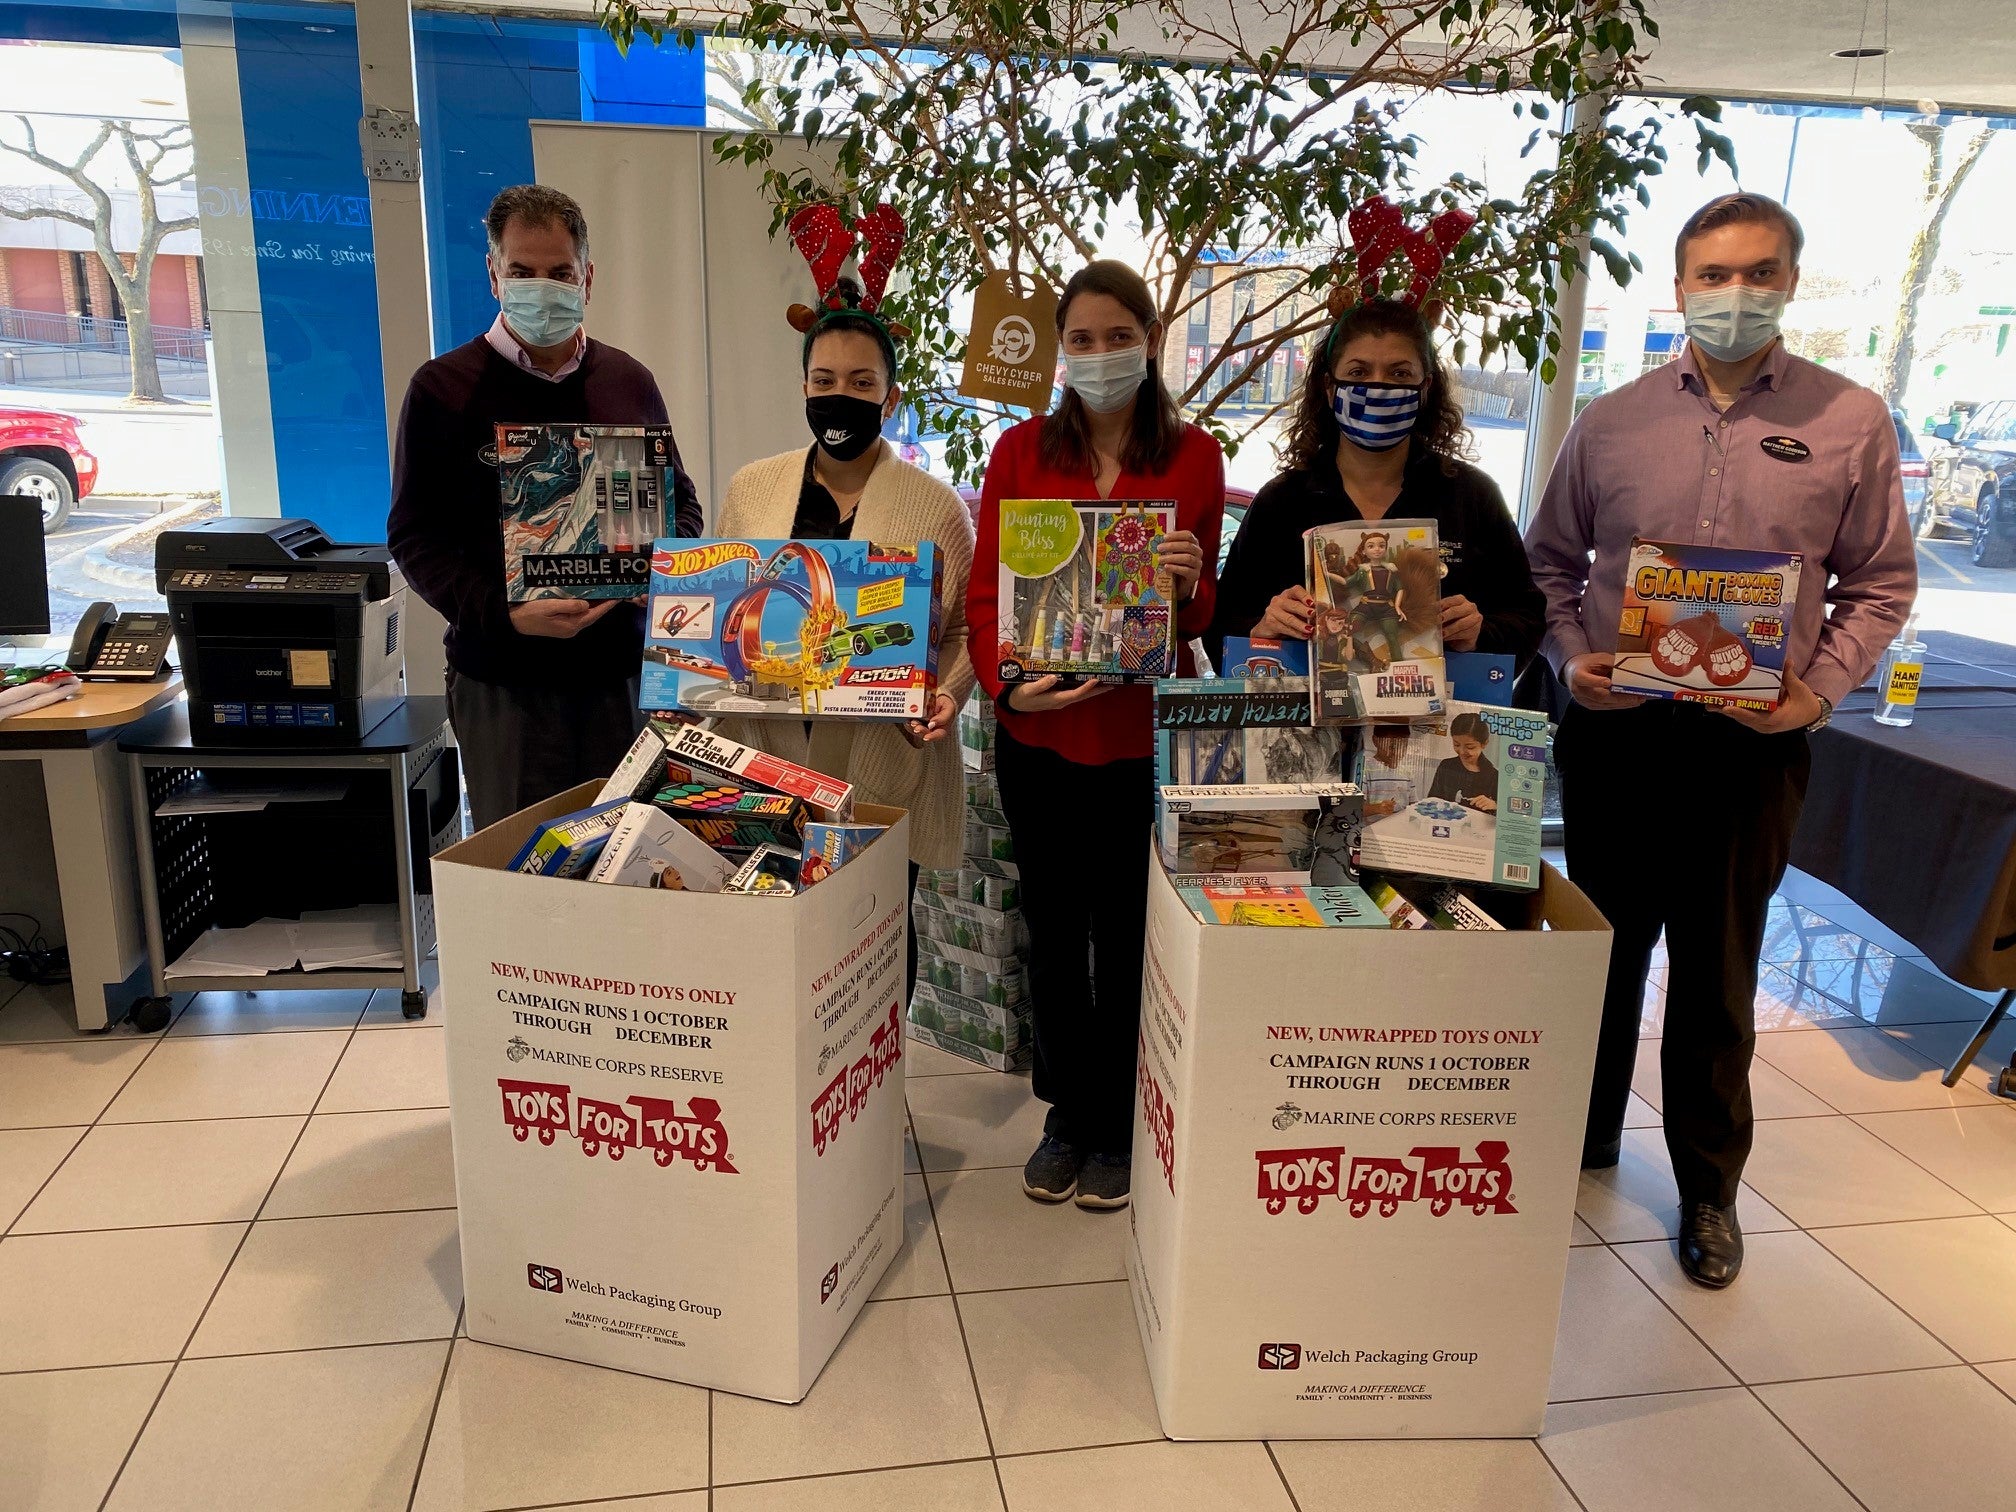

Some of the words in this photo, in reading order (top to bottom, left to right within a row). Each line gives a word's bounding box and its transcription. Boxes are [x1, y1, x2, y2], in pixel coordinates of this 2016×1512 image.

[976, 362, 1008, 378] CHEVY
[1010, 369, 1042, 383] CYBER
[983, 375, 1005, 386] SALES
[1007, 378, 1031, 390] EVENT
[661, 429, 671, 437] 6+
[825, 429, 846, 440] NIKE
[655, 439, 664, 453] 6
[1005, 510, 1068, 532] Painting
[1019, 530, 1055, 550] Bliss
[526, 558, 611, 576] MARBLE
[537, 577, 598, 586] ABSTRACT
[606, 576, 635, 584] WALL
[1635, 567, 1726, 603] GIANT
[1726, 572, 1782, 591] BOXING
[1723, 587, 1781, 606] GLOVES
[1754, 623, 1779, 636] RED
[1667, 628, 1699, 656] BOXING
[1709, 644, 1744, 664] BOXING
[256, 669, 283, 677] brother
[847, 666, 914, 684] ACTION
[1393, 665, 1418, 675] MARVEL
[1490, 670, 1504, 680] 3+
[1893, 670, 1920, 682] HAND
[1325, 690, 1349, 698] SQUIRREL
[1377, 675, 1434, 694] RISING
[1696, 694, 1701, 703] 2
[1704, 695, 1724, 706] SETS
[1736, 699, 1770, 711] BRAWL!
[1162, 705, 1233, 725] ARTIST
[1240, 701, 1311, 726] SKETCH
[1479, 712, 1513, 727] Polar
[1514, 716, 1546, 731] Bear
[1489, 722, 1533, 741] Plunge
[675, 740, 728, 766] KITCHEN
[708, 745, 723, 753] LAB
[822, 829, 836, 863] HEAD
[832, 833, 843, 864] STRIKE!
[735, 858, 757, 883] STUNTZ
[1175, 877, 1231, 886] FEARLESS
[1234, 876, 1268, 885] FLYER
[811, 970, 833, 997] NEW,
[834, 931, 876, 979] UNWRAPPED
[876, 913, 892, 940] TOYS
[890, 899, 905, 925] ONLY
[814, 974, 857, 1020] CAMPAIGN
[856, 958, 873, 985] RUNS
[877, 925, 903, 960] OCTOBER
[490, 961, 529, 983] NEW,
[532, 969, 636, 996] UNWRAPPED
[639, 983, 684, 1001] TOYS
[689, 989, 737, 1005] ONLY
[822, 989, 859, 1033] THROUGH
[867, 947, 898, 990] DECEMBER
[497, 988, 580, 1014] CAMPAIGN
[584, 1003, 627, 1021] RUNS
[632, 1010, 639, 1022] 1
[643, 1011, 729, 1031] OCTOBER
[831, 1022, 858, 1057] MARINE
[858, 1000, 878, 1031] CORPS
[878, 974, 901, 1013] RESERVE
[512, 1010, 592, 1035] THROUGH
[615, 1026, 712, 1050] DECEMBER
[1266, 1025, 1314, 1043] NEW,
[1318, 1027, 1437, 1044] UNWRAPPED
[1440, 1029, 1489, 1044] TOYS
[1493, 1029, 1544, 1044] ONLY
[532, 1047, 592, 1069] MARINE
[595, 1057, 646, 1076] CORPS
[650, 1065, 724, 1085] RESERVE
[1269, 1053, 1371, 1070] CAMPAIGN
[1375, 1055, 1424, 1070] RUNS
[1429, 1056, 1437, 1070] 1
[1441, 1056, 1530, 1071] OCTOBER
[815, 1082, 845, 1135] TOYS
[850, 1066, 870, 1094] FOR
[875, 1027, 897, 1067] TOTS
[1286, 1075, 1381, 1090] THROUGH
[1407, 1076, 1511, 1091] DECEMBER
[505, 1091, 566, 1125] TOYS
[580, 1104, 630, 1142] FOR
[646, 1118, 718, 1156] TOTS
[1304, 1110, 1375, 1125] MARINE
[1379, 1111, 1435, 1126] CORPS
[1440, 1111, 1518, 1126] RESERVE
[1263, 1156, 1335, 1192] TOYS
[1350, 1163, 1408, 1196] FOR
[1427, 1166, 1502, 1199] TOTS
[566, 1277, 606, 1296] Welch
[609, 1286, 676, 1312] Packaging
[679, 1299, 722, 1319] Group
[565, 1318, 589, 1328] FAMILY
[601, 1326, 643, 1340] COMMUNITY
[654, 1336, 686, 1347] BUSINESS
[571, 1311, 608, 1325] MAKING
[610, 1319, 617, 1327] A
[618, 1320, 679, 1339] DIFFERENCE
[1305, 1349, 1350, 1363] Welch
[1355, 1349, 1428, 1365] Packaging
[1432, 1349, 1478, 1364] Group
[1305, 1384, 1348, 1393] MAKING
[1349, 1385, 1357, 1393] A
[1358, 1384, 1427, 1393] DIFFERENCE
